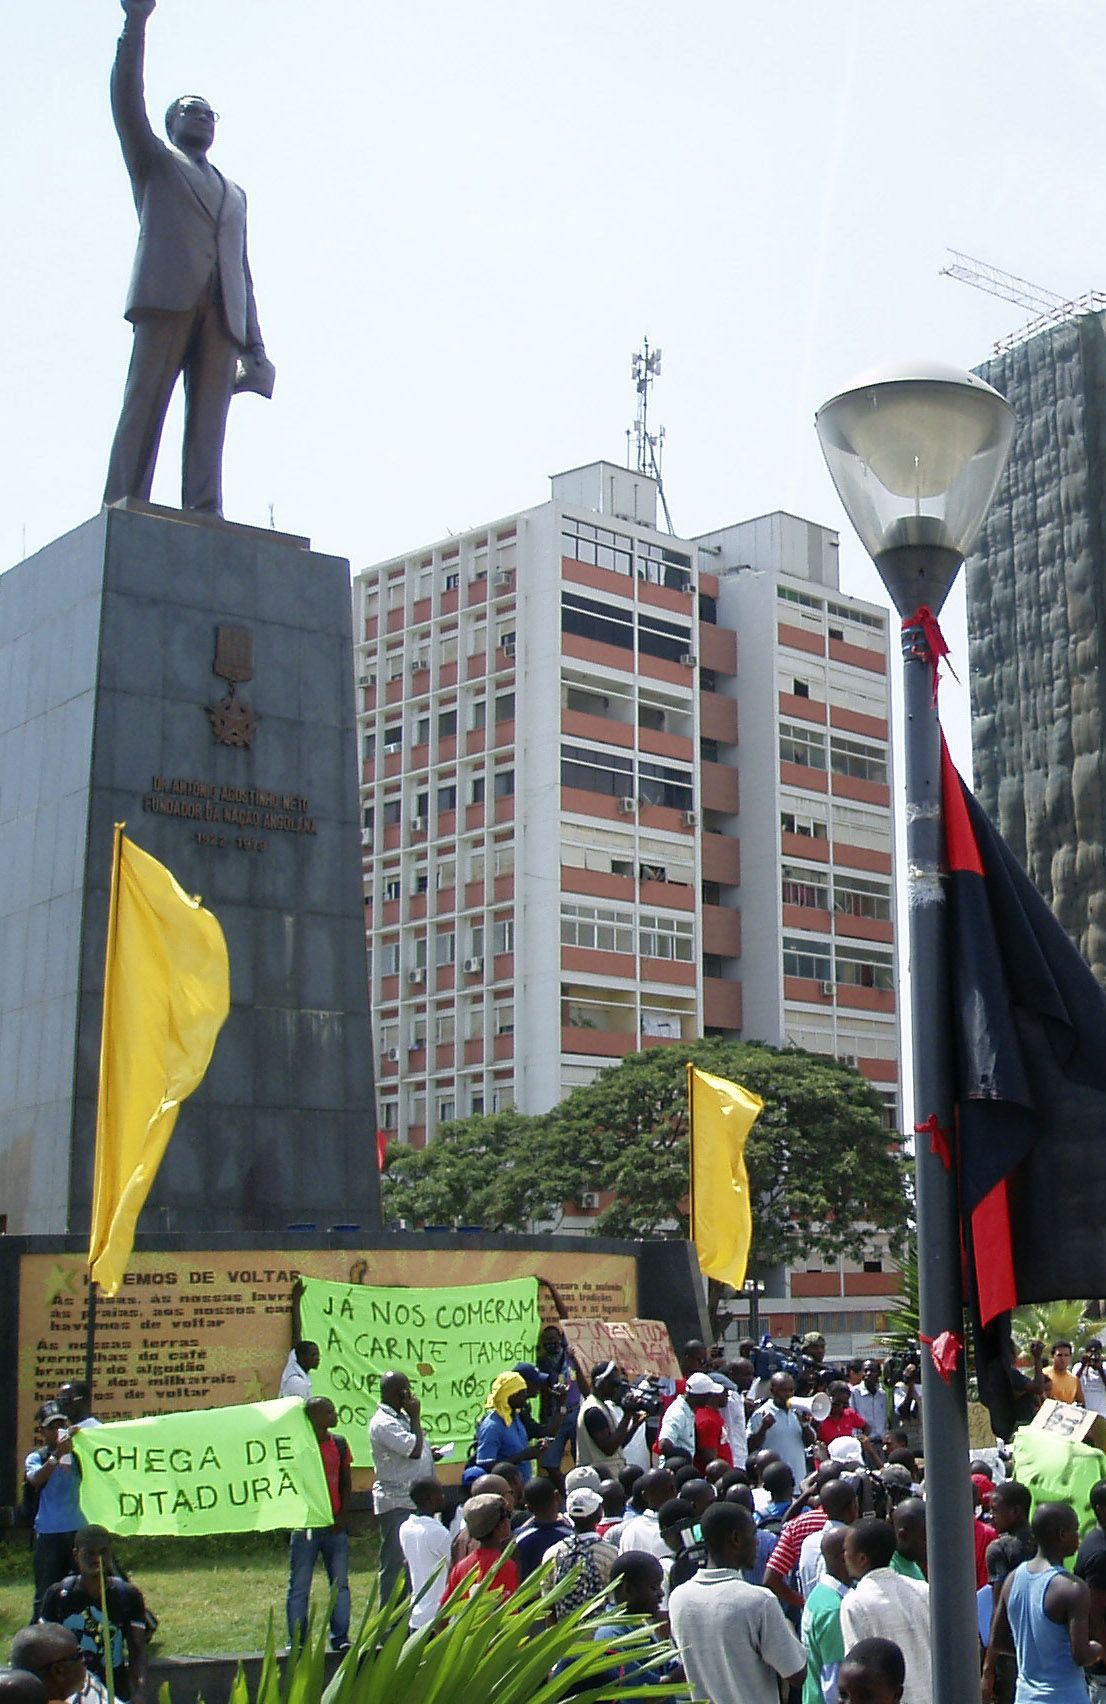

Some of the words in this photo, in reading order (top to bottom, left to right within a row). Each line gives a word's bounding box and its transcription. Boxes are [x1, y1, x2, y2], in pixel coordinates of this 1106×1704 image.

[189, 1271, 214, 1284] DE
[323, 1288, 354, 1321] JÁ
[372, 1301, 425, 1328] NOS
[436, 1298, 535, 1330] COMERAM
[140, 1319, 161, 1330] de
[172, 1317, 226, 1329] voltar
[142, 1338, 200, 1349] terras
[327, 1327, 343, 1352] A
[354, 1334, 448, 1363] CARNE
[459, 1329, 537, 1365] TAMBÉM
[35, 1366, 101, 1377] brancs
[106, 1364, 126, 1375] do
[124, 1389, 145, 1400] de
[156, 1387, 210, 1400] voltar
[93, 1445, 222, 1473] CHEGA
[246, 1436, 296, 1466] DE
